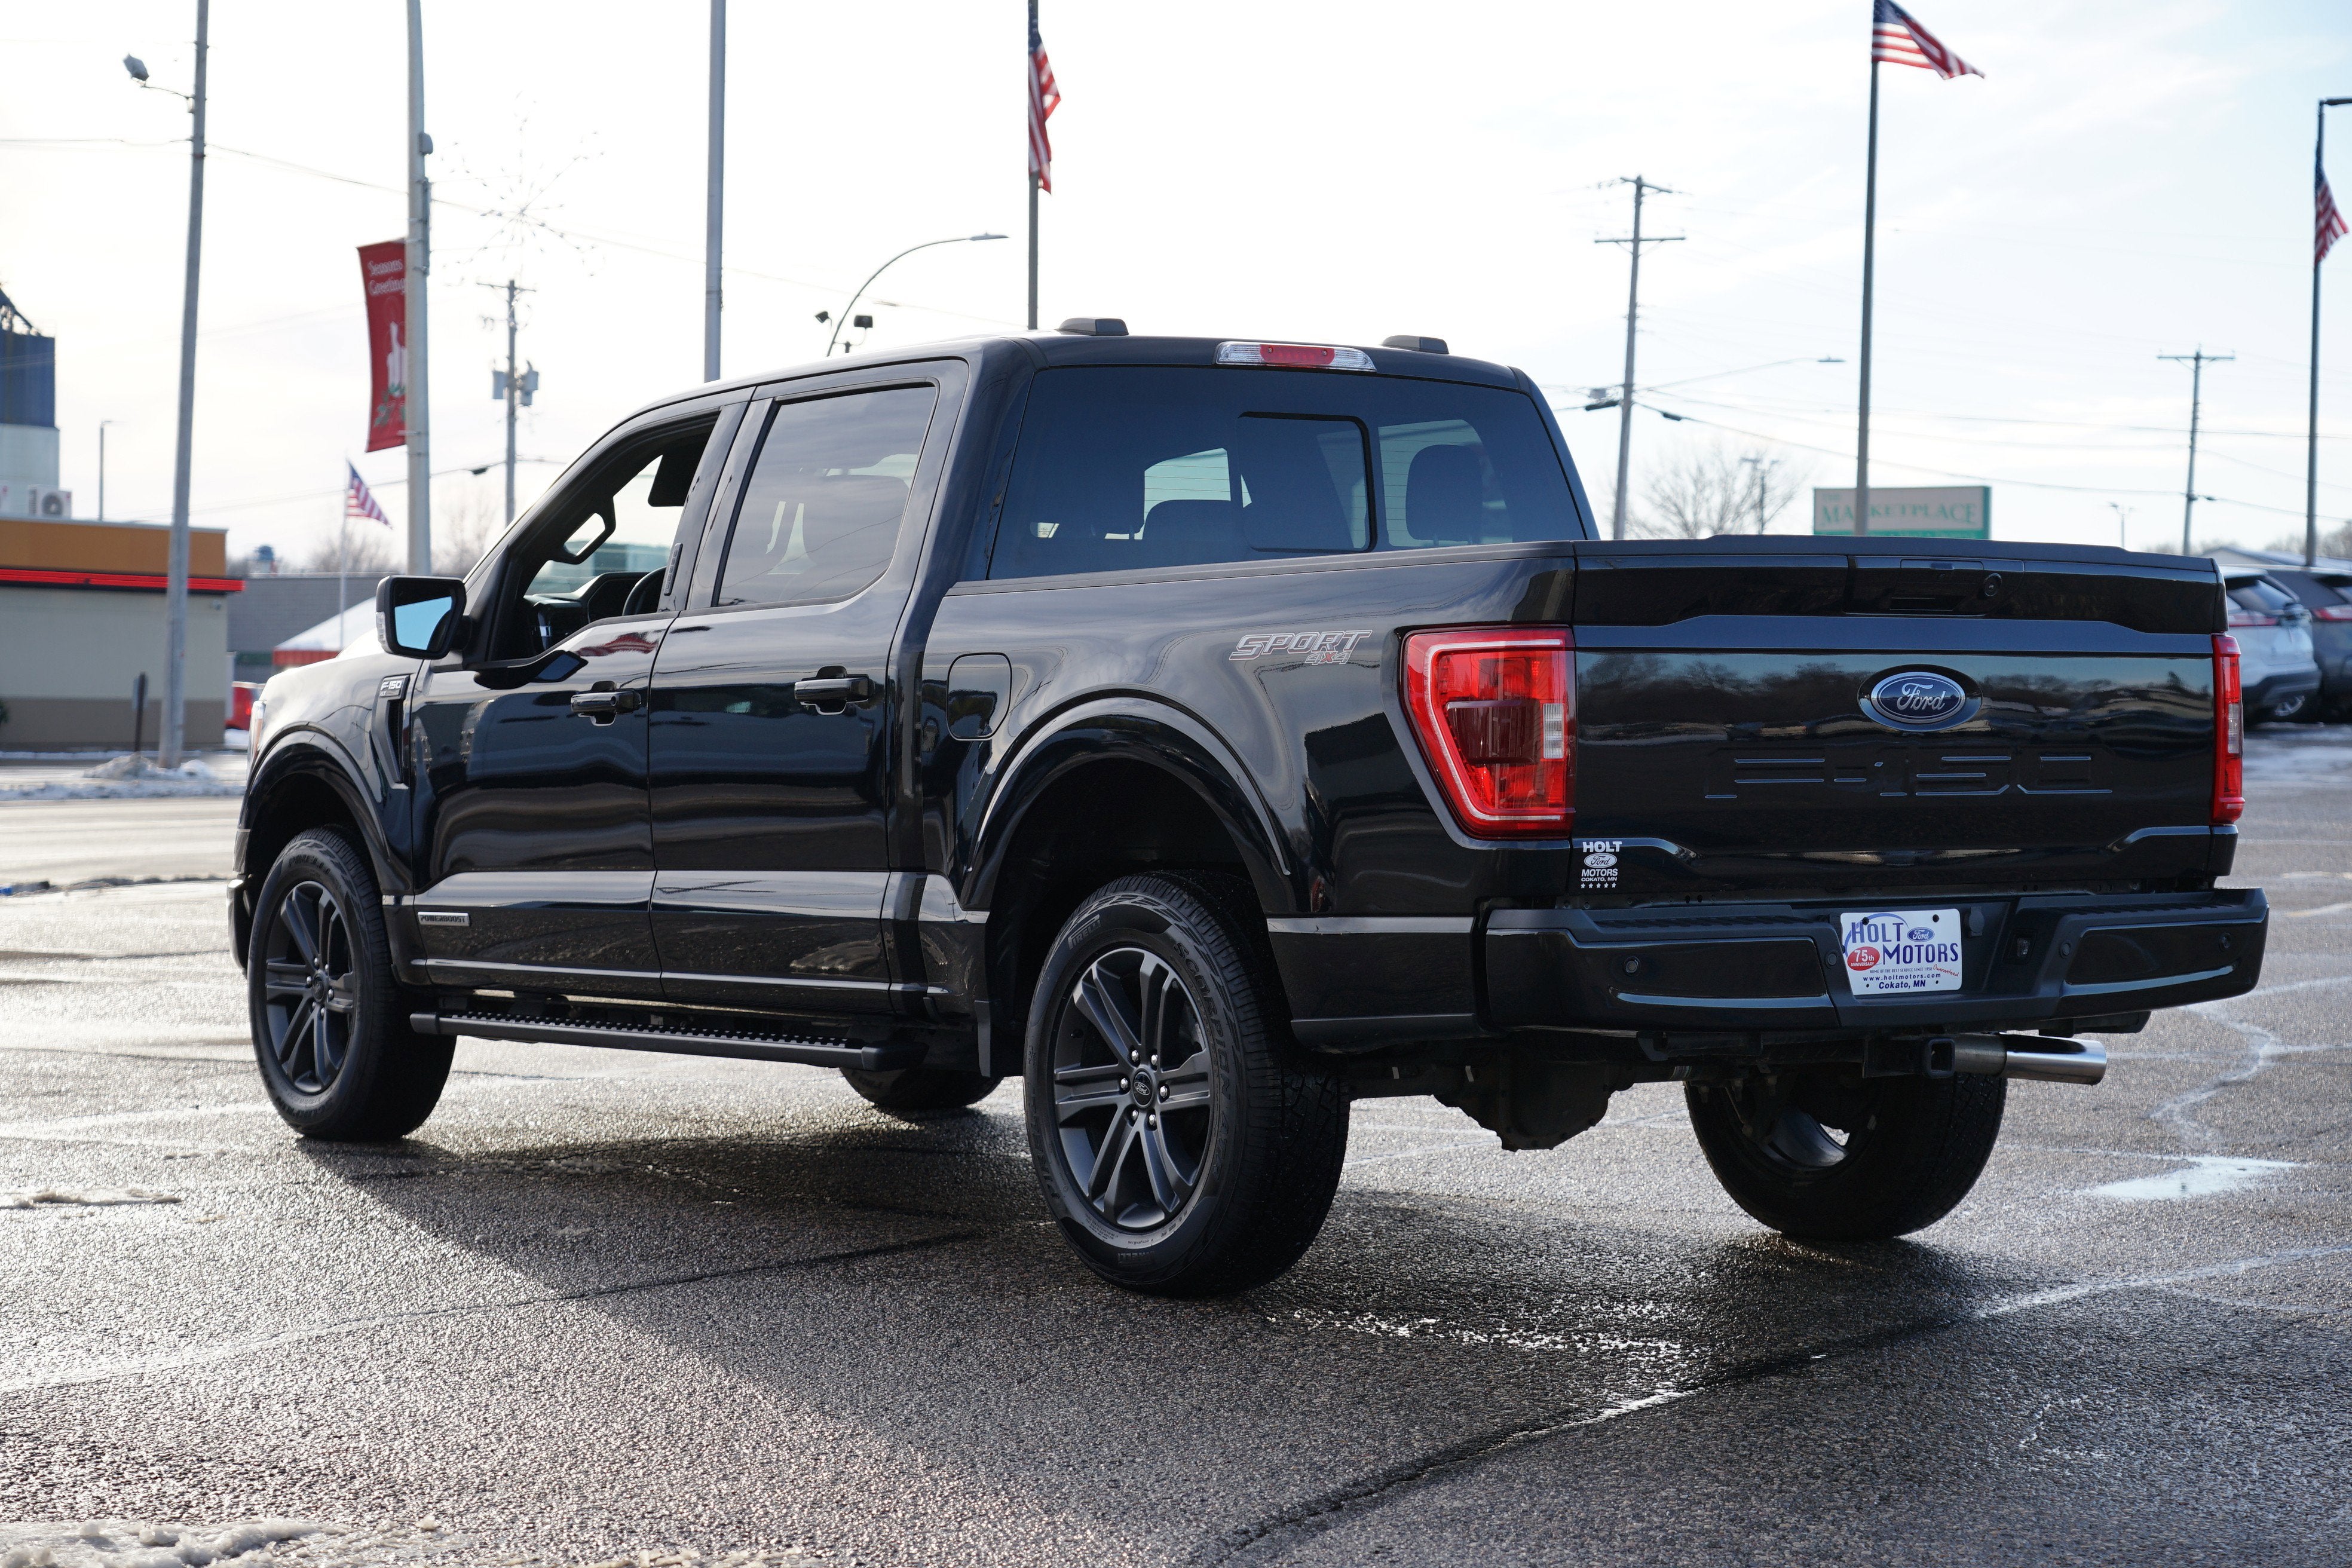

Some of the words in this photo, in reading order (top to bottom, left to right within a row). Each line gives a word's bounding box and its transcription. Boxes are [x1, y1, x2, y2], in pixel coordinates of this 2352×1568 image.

[368, 277, 406, 296] Greeting
[1820, 502, 1978, 526] MAKETPLACE
[1229, 629, 1373, 660] SPORT
[381, 680, 402, 690] F-150
[1897, 682, 1946, 710] Ford
[1582, 841, 1622, 853] HOLT
[1590, 855, 1610, 865] Ford
[1581, 868, 1618, 877] MOTORS
[1067, 914, 1102, 950] PIRELLI
[1851, 922, 1904, 944] HOLT
[1912, 929, 1930, 940] Ford
[1854, 950, 1875, 962] 75th
[1883, 943, 1959, 965] MOTORS
[1863, 973, 1941, 981] www.holtmotors.com
[1933, 964, 1959, 977] Guaranteed
[1879, 981, 1911, 990] Cokato,
[1913, 979, 1926, 988] MN
[1174, 942, 1232, 1101] SCORPION
